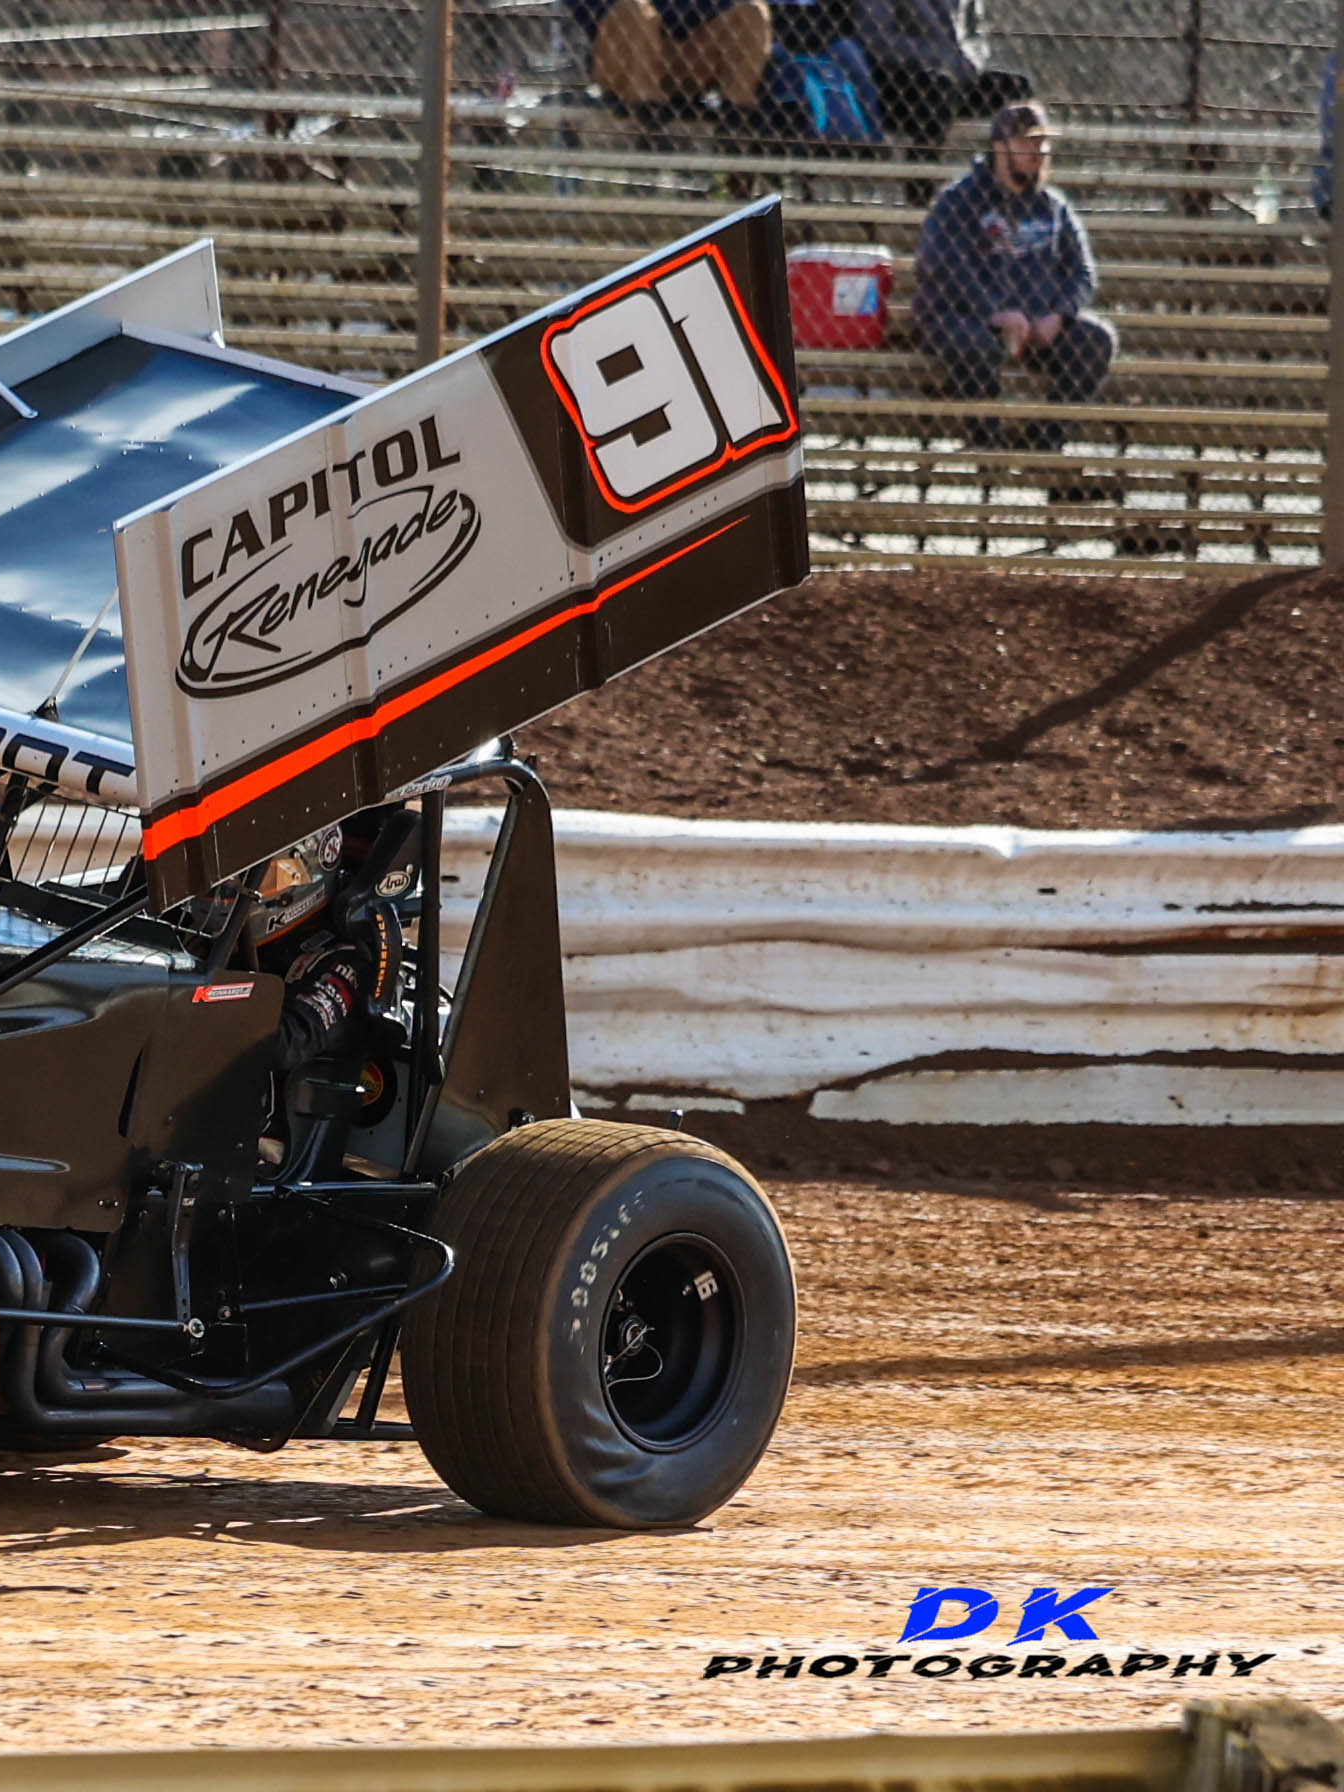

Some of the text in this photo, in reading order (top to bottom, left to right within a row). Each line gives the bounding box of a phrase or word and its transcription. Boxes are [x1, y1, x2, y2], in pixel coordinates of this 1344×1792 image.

[549, 259, 784, 498] 91
[182, 416, 462, 600] CAPITOL
[196, 486, 462, 654] Renegade
